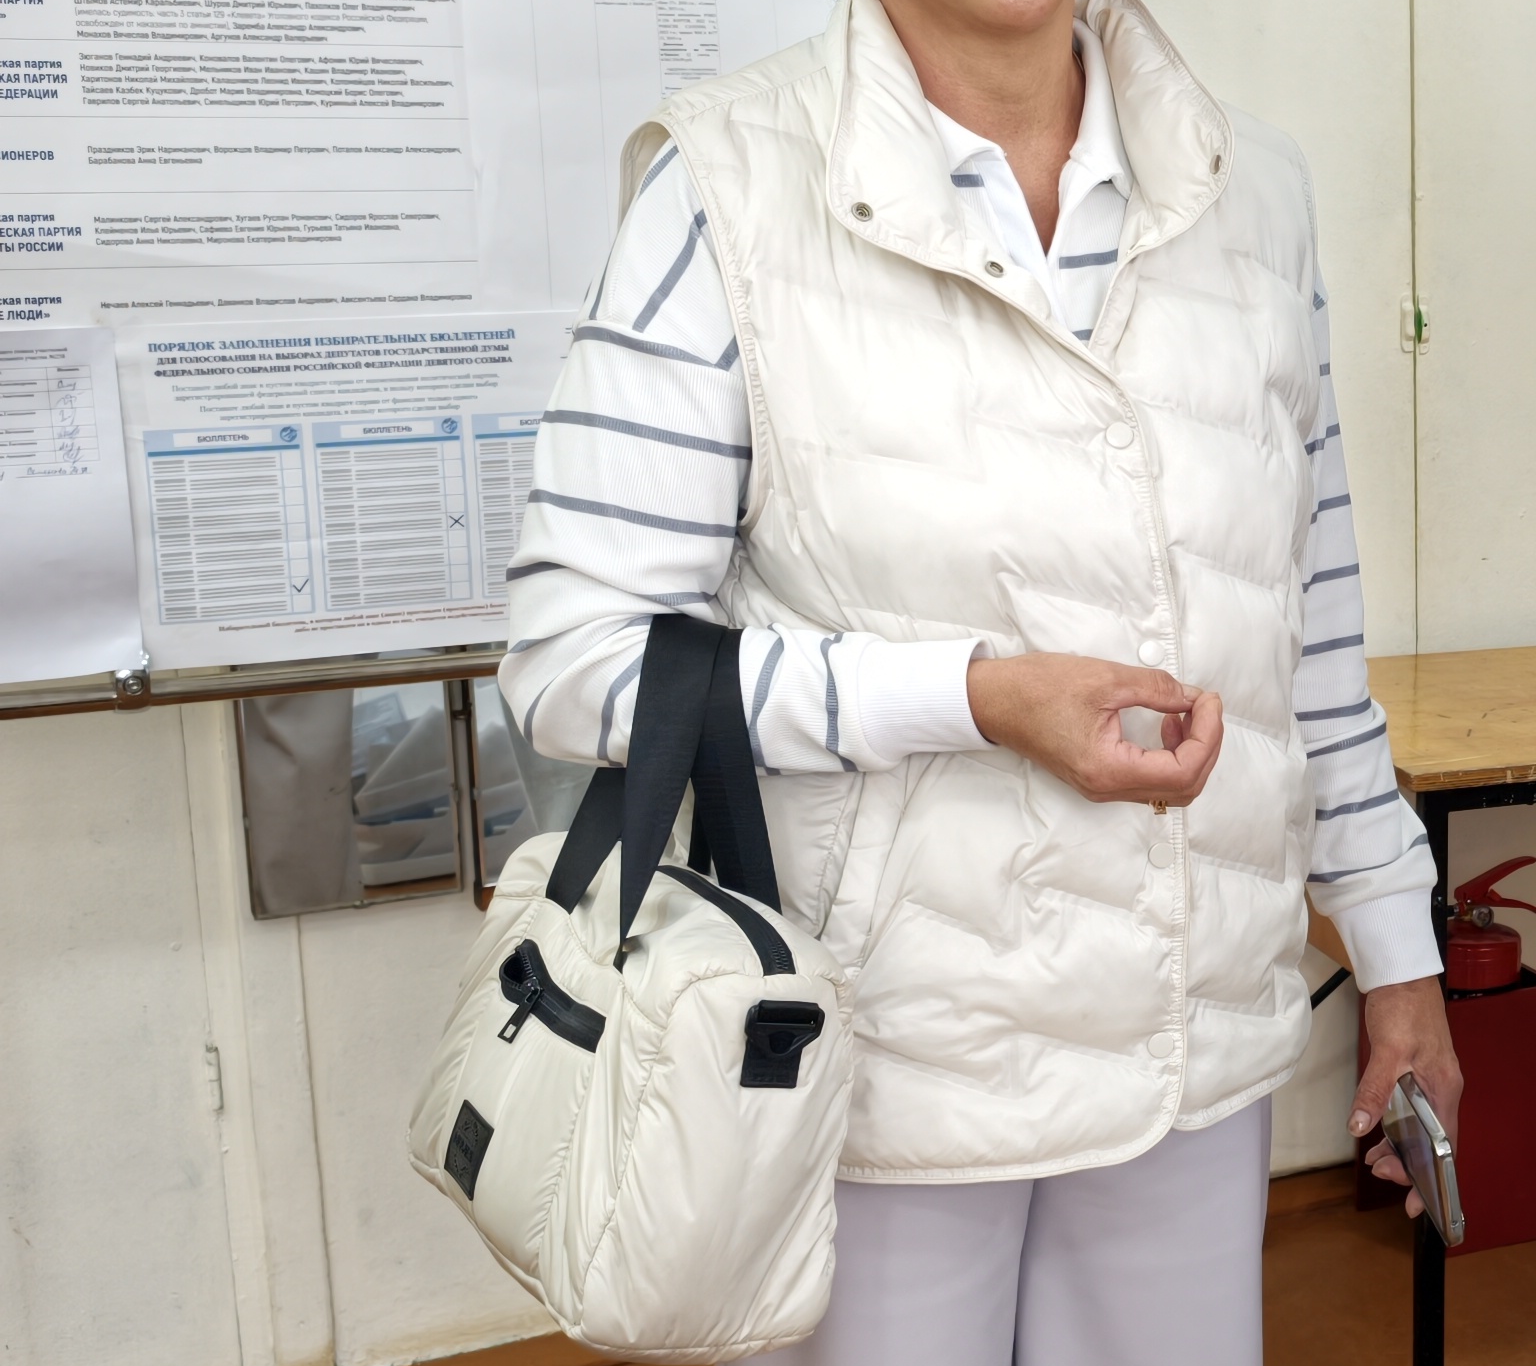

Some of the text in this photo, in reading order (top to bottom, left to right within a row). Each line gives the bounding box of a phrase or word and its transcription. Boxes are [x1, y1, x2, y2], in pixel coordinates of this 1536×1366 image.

[24, 61, 62, 71] партия
[24, 74, 68, 84] ПАРТИЯ
[0, 151, 55, 161] ИОНЕРОВ
[18, 214, 55, 224] партия
[38, 227, 82, 237] ПАРТИЯ
[18, 242, 64, 252] РОССИИ
[24, 297, 62, 306] партия
[7, 310, 50, 321] ЛЮДИ»
[148, 329, 515, 352] ПОРЯДОК ЗАПОЛНЕНИЯ ИЗБИРАТЕЛЬНЫХ БЮЛЛЕТЕНЕЙ
[156, 357, 178, 365] ДЛЯ
[179, 354, 256, 363] ГОЛОСОВАНИЯ
[275, 352, 323, 360] ВЫБОРАХ
[324, 349, 382, 358] ДЕПУТАТОВ
[383, 345, 478, 355] ГОСУДАРСТВЕННОЙ
[480, 344, 509, 352] ДУМЫ
[154, 356, 512, 377] ФЕДЕРАЛЬНОГО СОБРАНИЯ РОССИЙСКОЙ ФЕДЕРАЦИИ ДЕВЯТОГО СОЗЫВА
[363, 426, 412, 435] БЮЛЛЕТЕНЬ
[198, 434, 249, 444] БЮЛЛЕТЕНЬ
